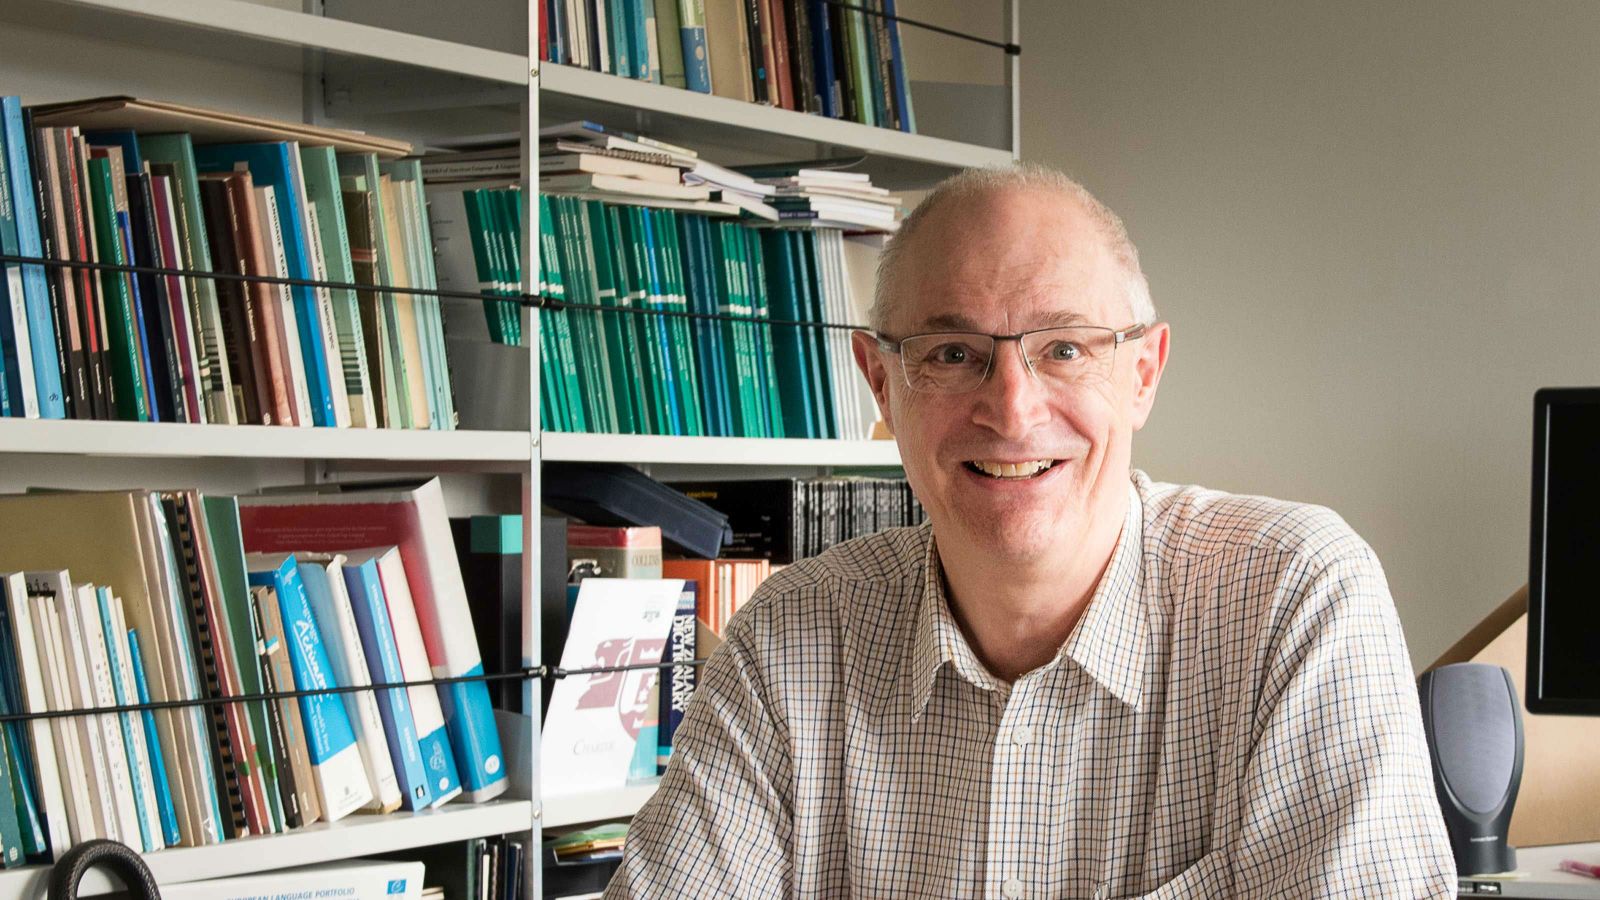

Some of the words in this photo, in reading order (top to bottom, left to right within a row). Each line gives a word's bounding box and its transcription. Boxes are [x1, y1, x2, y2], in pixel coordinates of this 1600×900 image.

[270, 195, 281, 247] LANGUAGE
[280, 253, 290, 301] TEACING
[632, 554, 659, 567] COLLINS
[297, 583, 319, 644] Language
[684, 614, 696, 645] NEW
[296, 620, 333, 699] Activatr
[671, 615, 685, 713] DICTIONARY
[269, 891, 313, 900] LANGUAGE
[314, 887, 355, 898] PORTFOLIO
